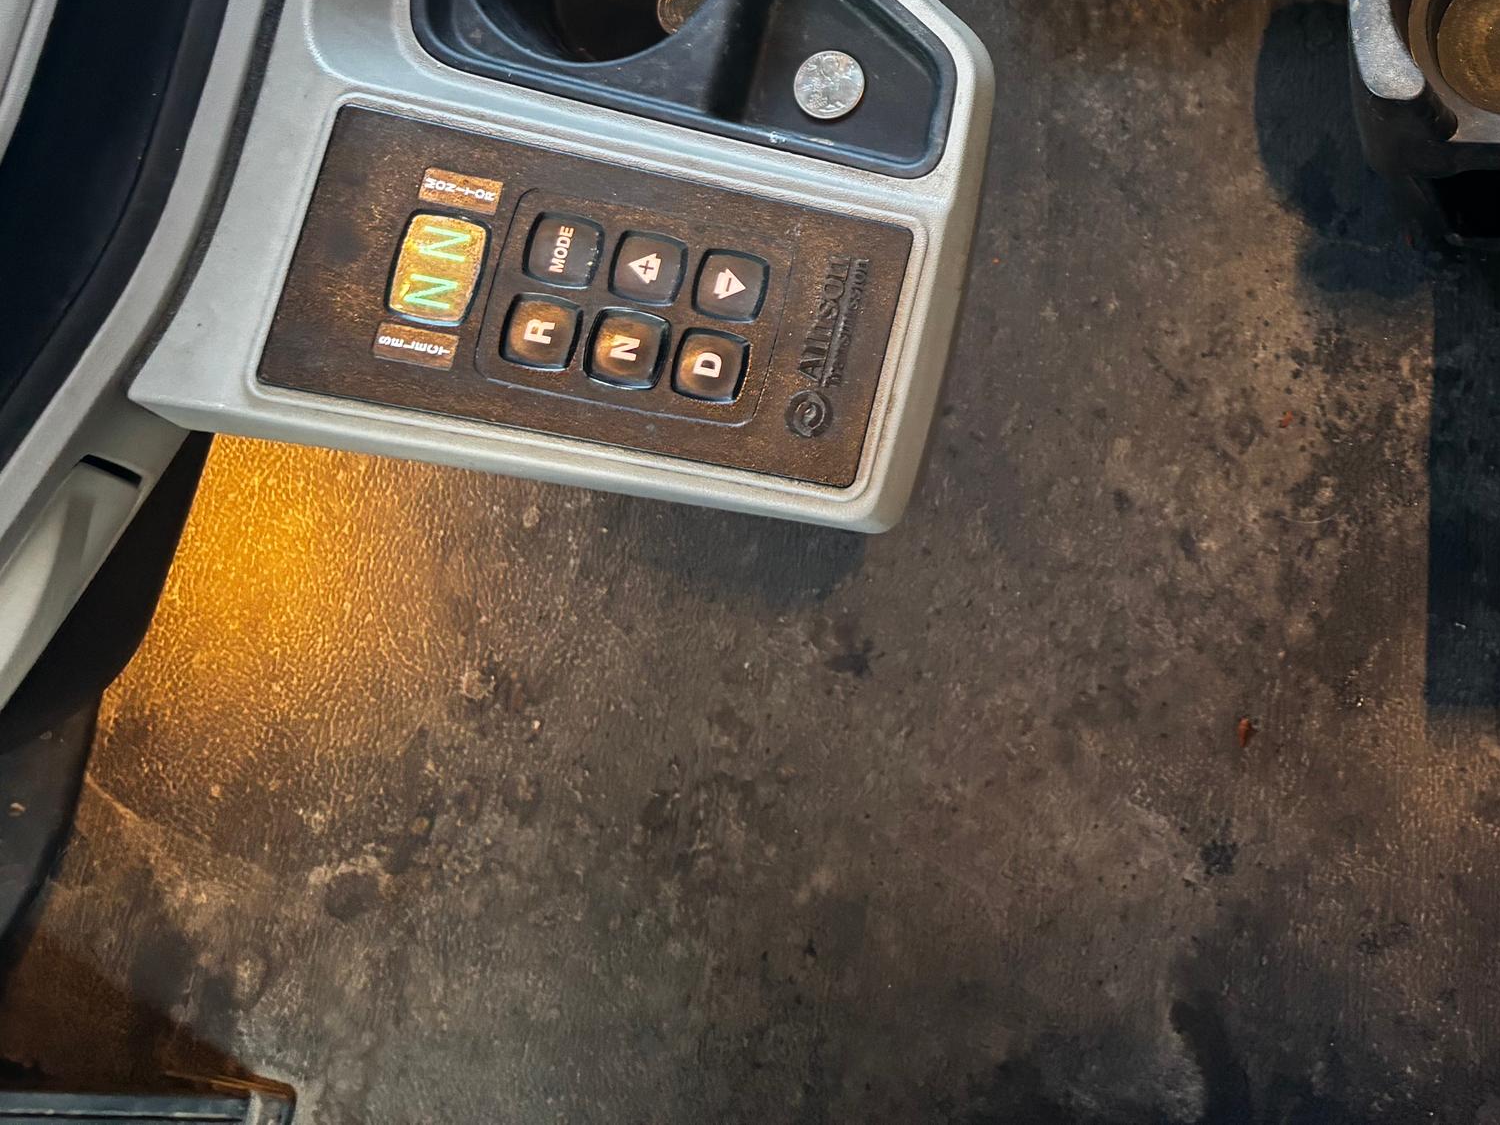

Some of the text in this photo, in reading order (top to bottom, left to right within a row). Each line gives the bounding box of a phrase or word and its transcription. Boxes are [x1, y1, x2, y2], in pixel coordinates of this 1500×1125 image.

[424, 177, 496, 202] MONITOR
[549, 225, 575, 273] MODE
[402, 225, 472, 309] N N
[523, 318, 556, 345] R
[797, 255, 851, 383] Allison
[378, 335, 451, 356] SELECT
[609, 334, 641, 362] N
[693, 351, 722, 378] D
